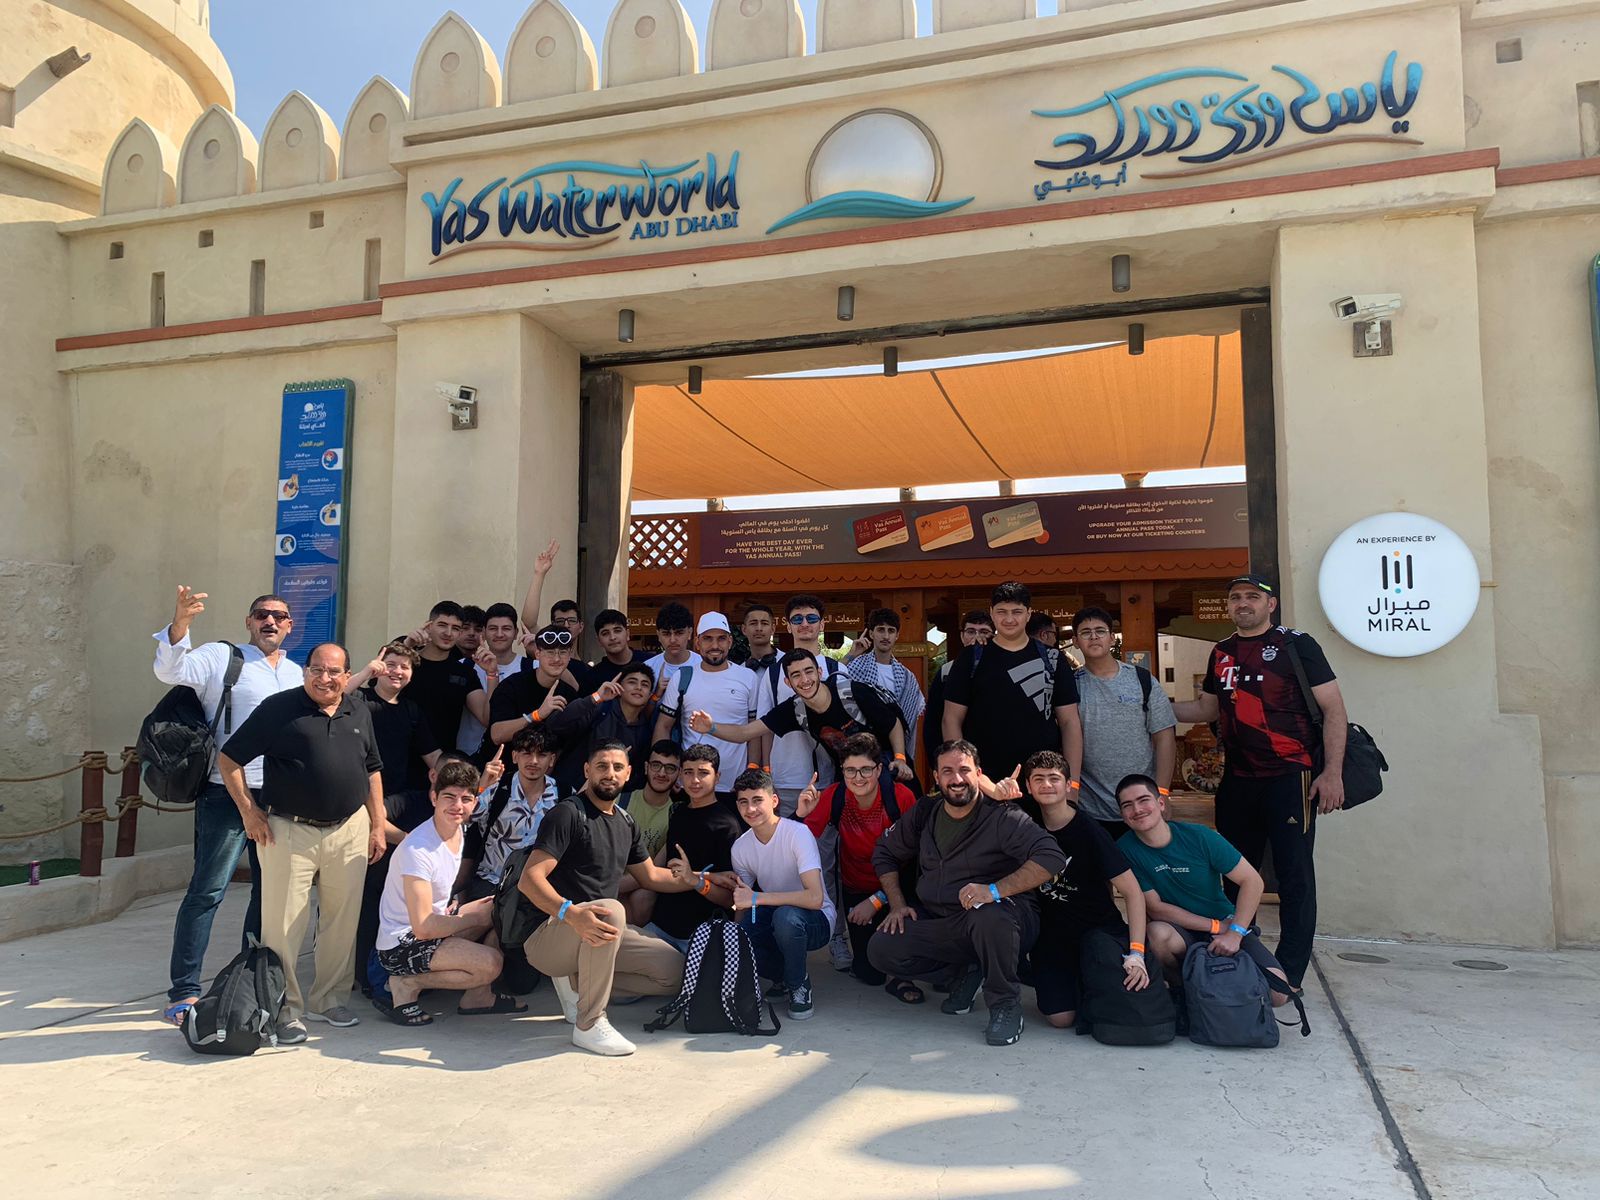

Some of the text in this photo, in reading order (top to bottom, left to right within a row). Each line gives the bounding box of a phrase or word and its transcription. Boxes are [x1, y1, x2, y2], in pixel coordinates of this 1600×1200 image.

[1271, 49, 1423, 134] ياس
[420, 149, 740, 257] Yas Waterworld
[629, 211, 739, 240] ABU DHABI
[1370, 535, 1423, 544] EXPERIENCE
[1367, 597, 1430, 616] ميرال
[1368, 617, 1431, 632] MIRAL
